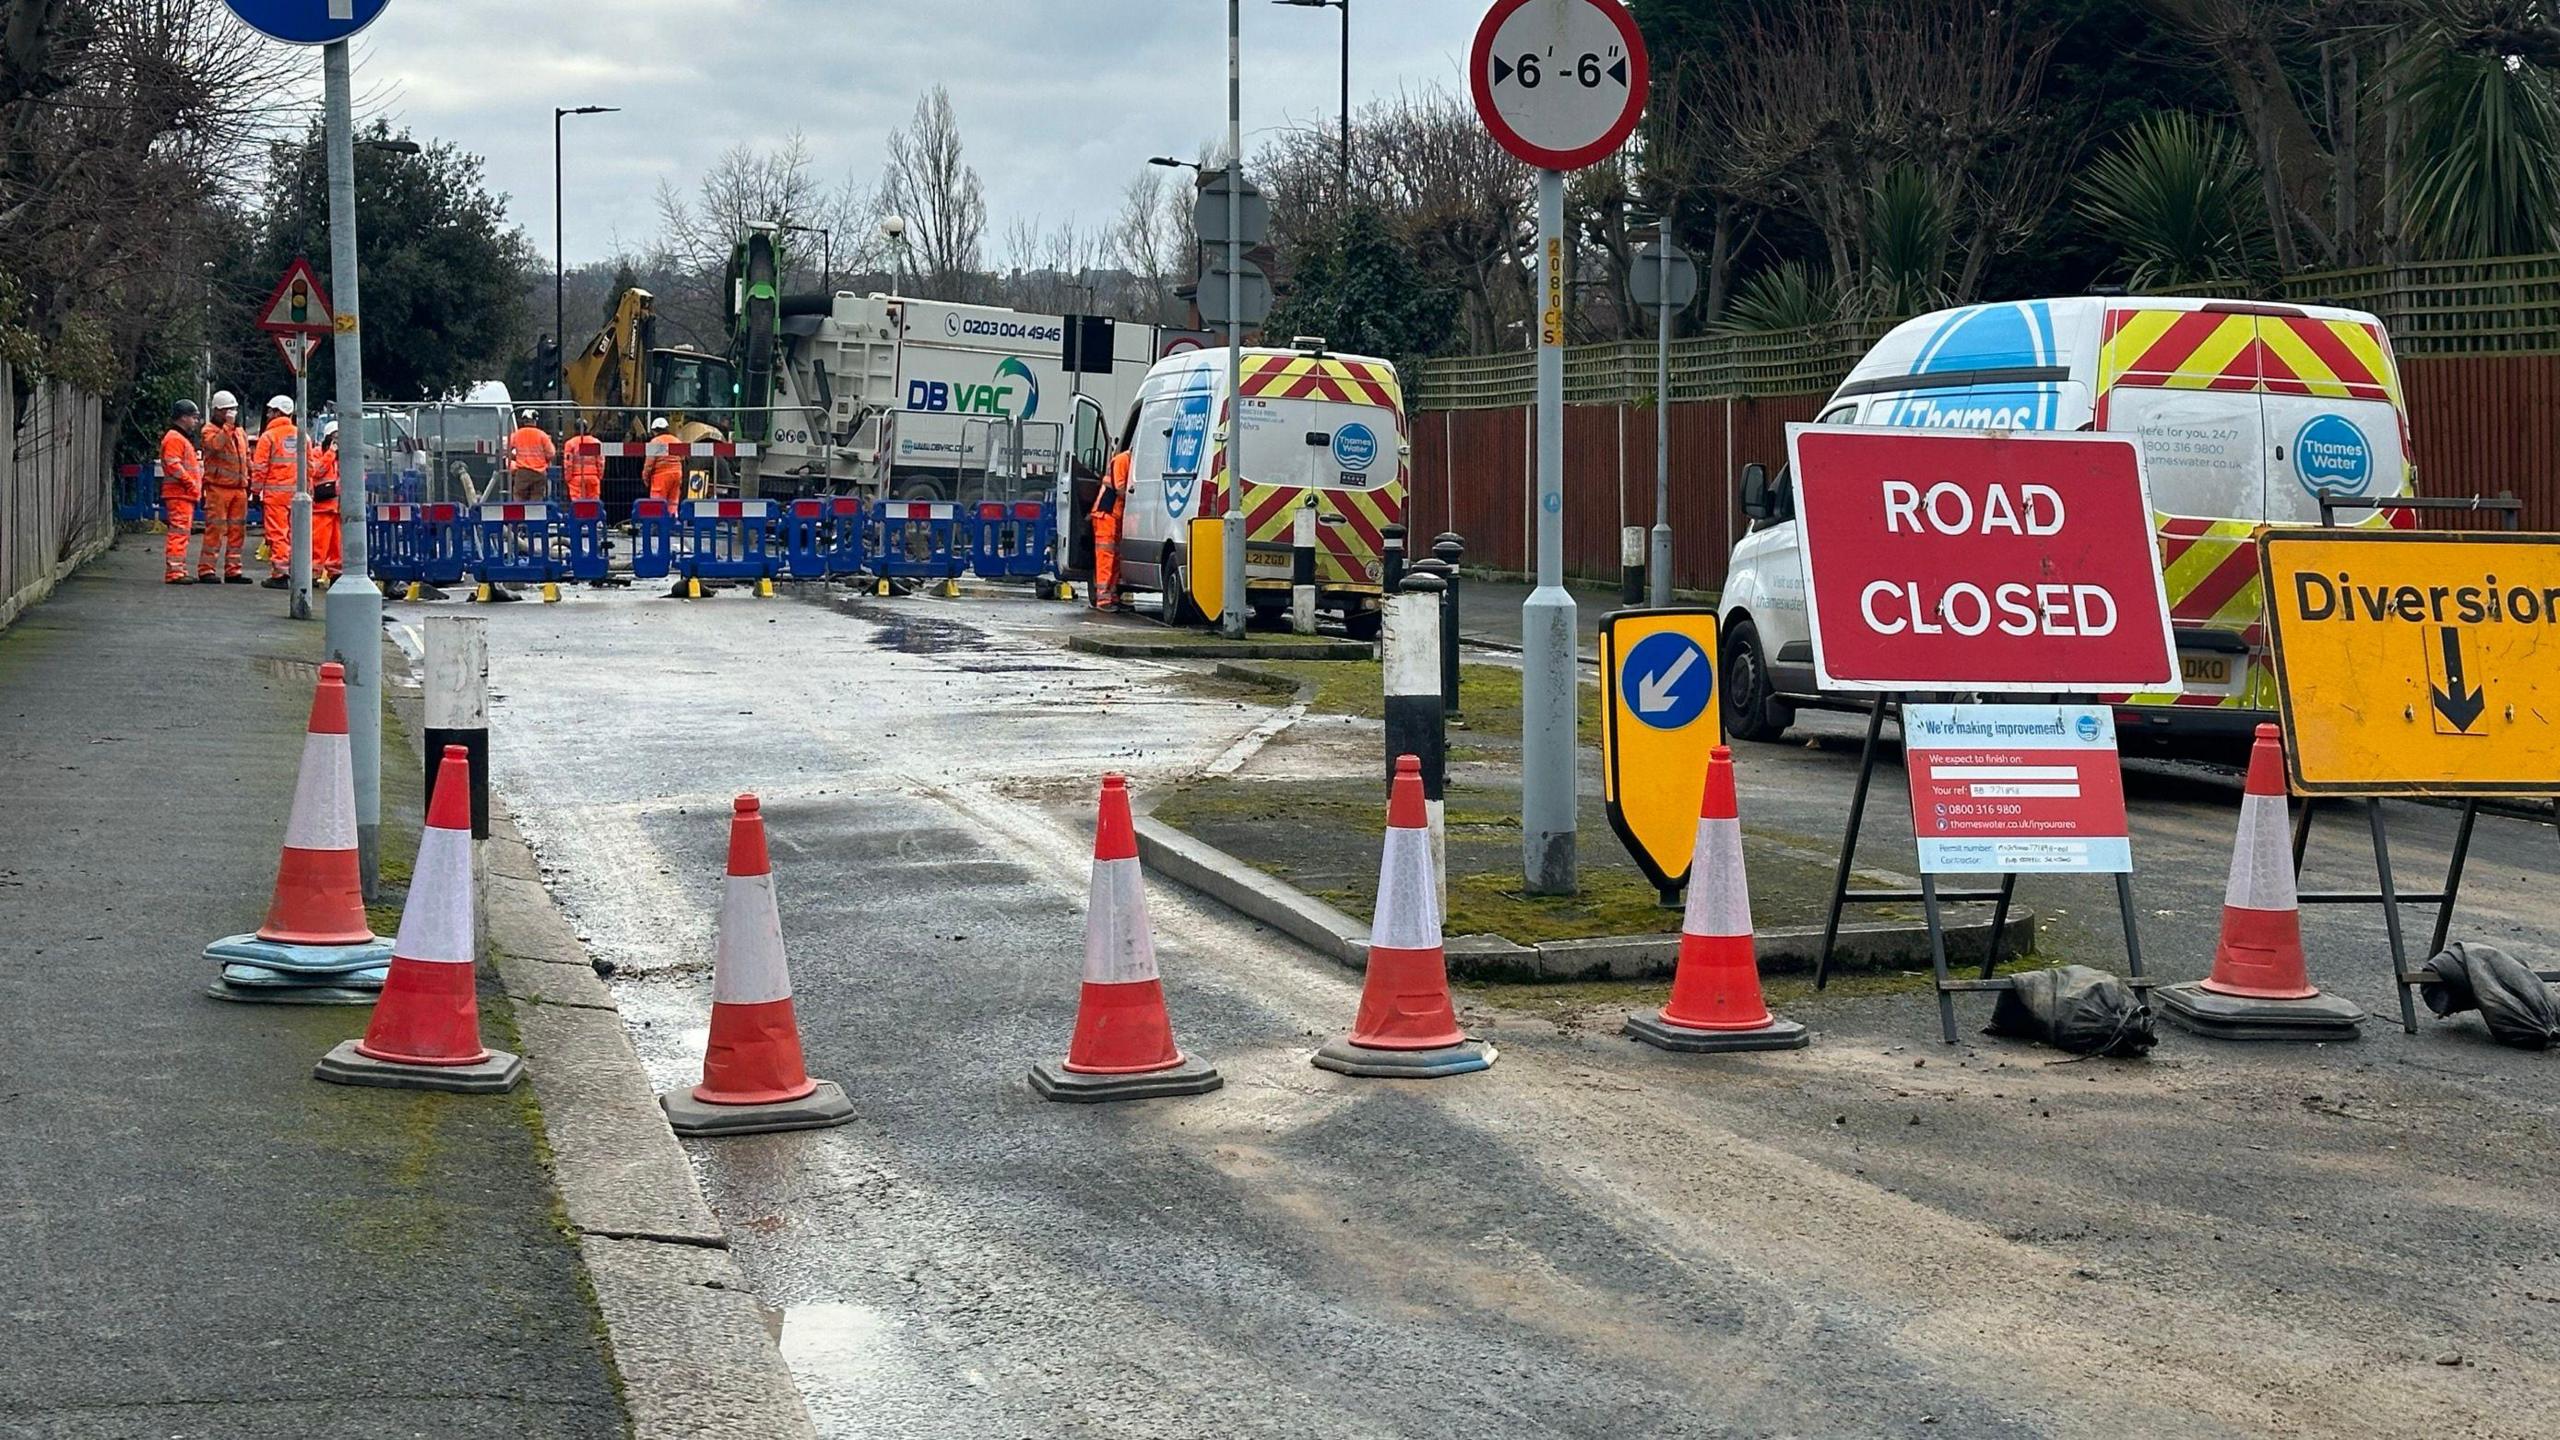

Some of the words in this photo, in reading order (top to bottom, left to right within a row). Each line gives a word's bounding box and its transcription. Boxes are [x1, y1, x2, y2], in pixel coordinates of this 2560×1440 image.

[963, 320, 998, 336] 0203
[1000, 323, 1026, 338] 004
[1027, 326, 1061, 342] 4946
[907, 379, 949, 412] DB
[953, 382, 1013, 415] VAC
[1177, 409, 1206, 431] Thames
[1339, 435, 1372, 447] Thames
[2167, 425, 2183, 437] for
[2212, 429, 2239, 441] 24/7
[1175, 434, 1198, 456] Water
[1343, 444, 1369, 454] Water
[2145, 441, 2171, 452] 800
[2173, 442, 2191, 453] 316
[2194, 443, 2225, 455] 9800
[2304, 440, 2363, 456] Thames
[2147, 456, 2242, 470] ameswater.co.uk
[2312, 454, 2357, 470] Water
[1882, 480, 2066, 536] ROAD
[1860, 580, 2118, 637] CLOSED
[1926, 720, 1953, 735] We're
[1956, 720, 1994, 738] making
[1995, 721, 2066, 738] improvements
[1929, 754, 1944, 764] We
[1945, 755, 1973, 766] expect
[1975, 755, 1985, 764] to
[1986, 754, 2009, 764] finish
[1932, 786, 1952, 795] Your
[1948, 804, 1974, 815] 0800
[1976, 805, 1995, 815] 316
[1997, 805, 2021, 815] 9800
